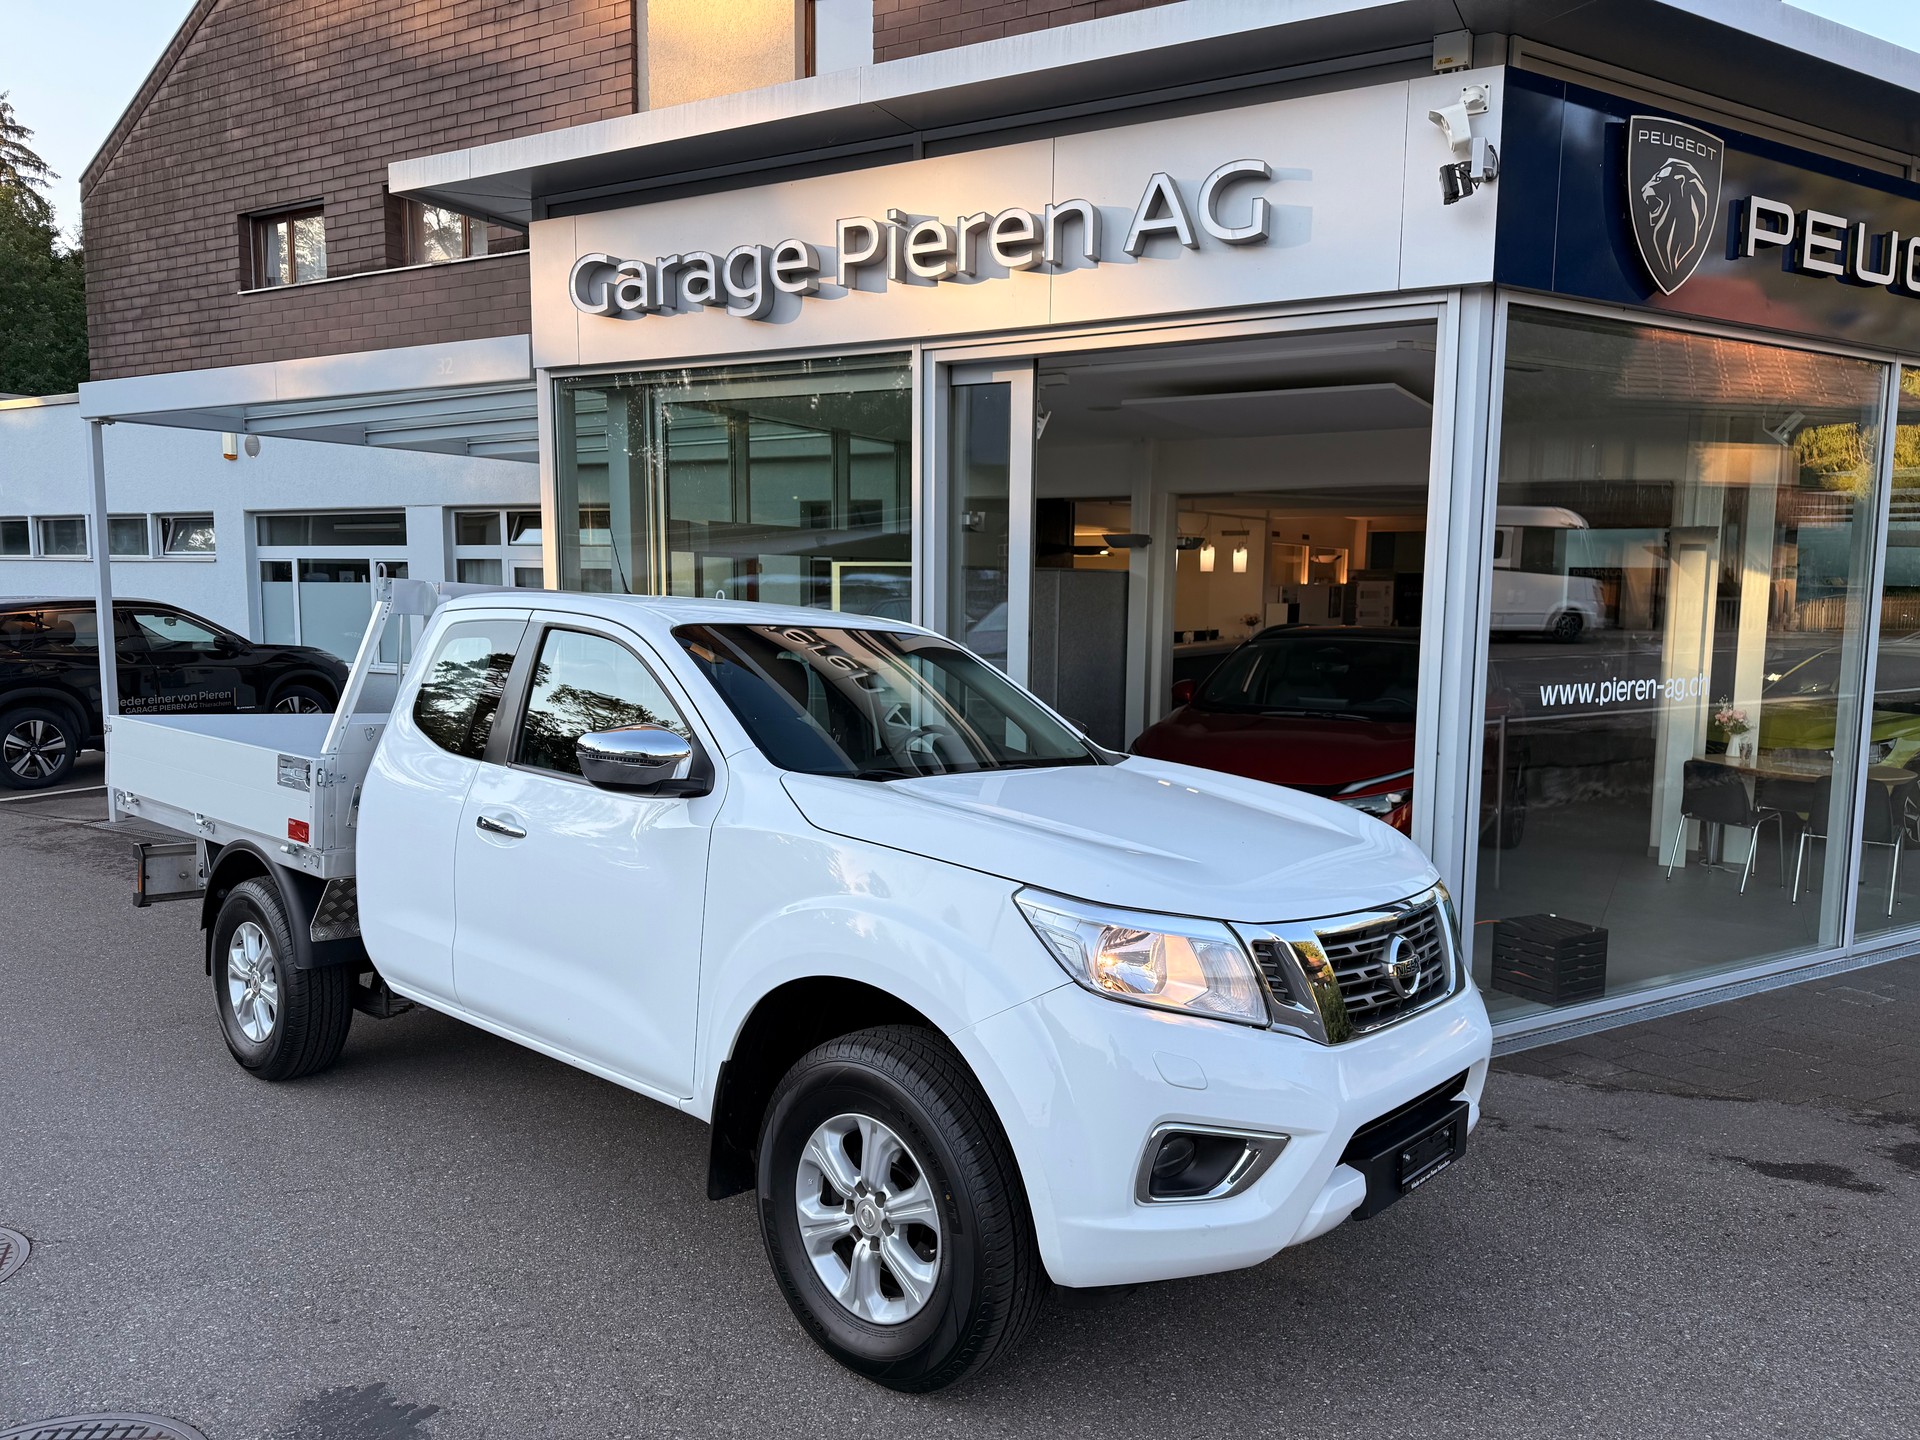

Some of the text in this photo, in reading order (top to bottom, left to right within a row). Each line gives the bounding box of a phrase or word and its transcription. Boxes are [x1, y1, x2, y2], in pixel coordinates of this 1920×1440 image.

[1638, 129, 1717, 161] PEUGEOT
[569, 158, 1273, 320] Garage Pieren AG
[436, 357, 454, 375] 32
[117, 690, 232, 707] eder einer von Pieren
[1539, 672, 1710, 707] www.pieren-ag.ch
[125, 705, 158, 714] GARAGE
[159, 703, 187, 712] PIEREN
